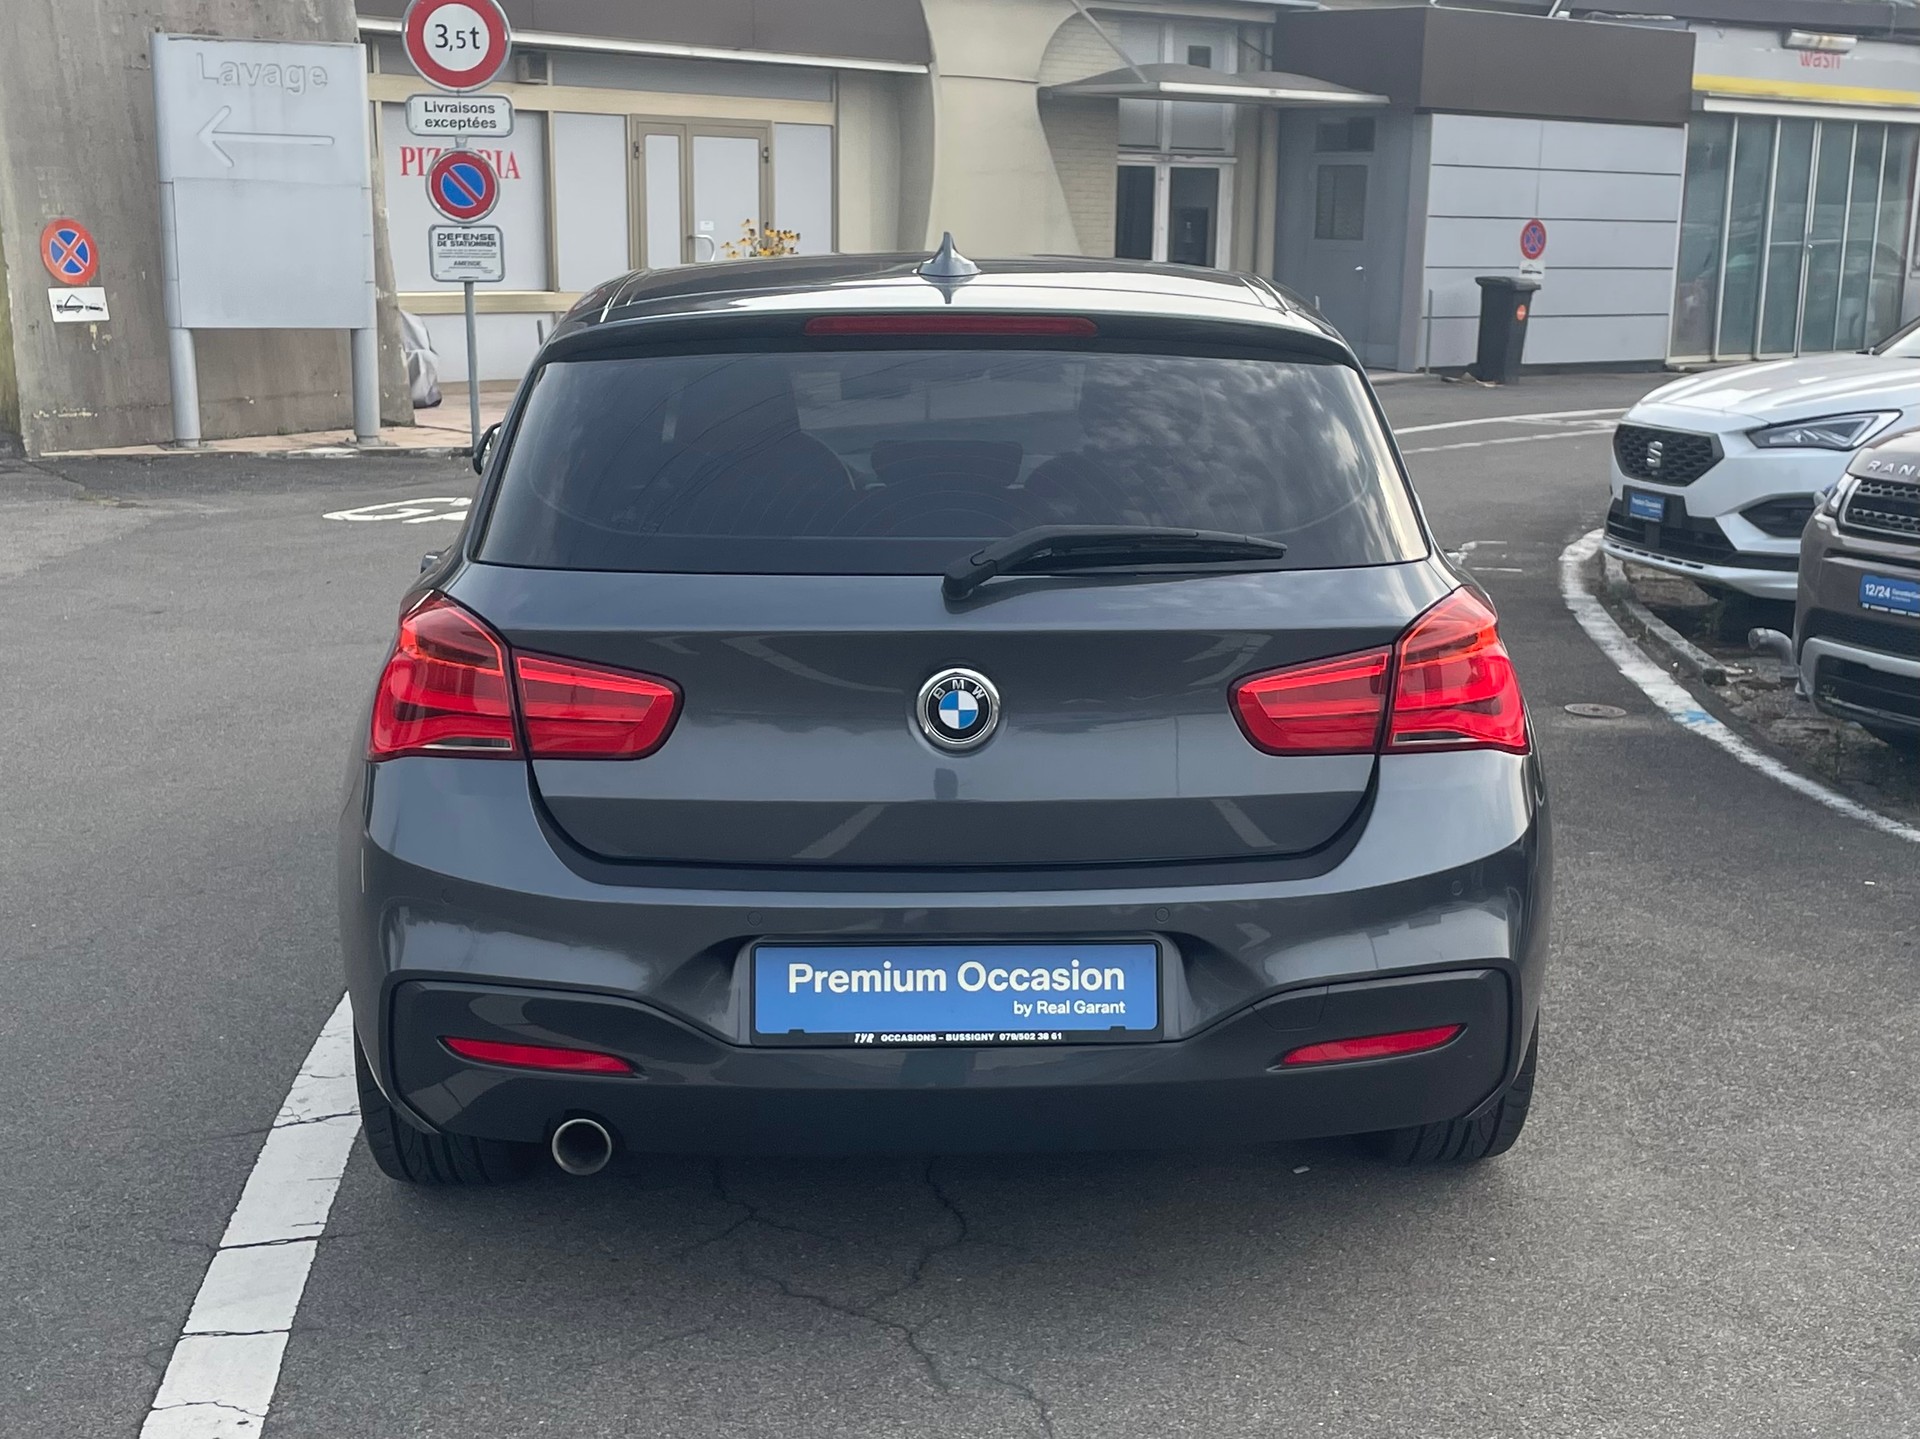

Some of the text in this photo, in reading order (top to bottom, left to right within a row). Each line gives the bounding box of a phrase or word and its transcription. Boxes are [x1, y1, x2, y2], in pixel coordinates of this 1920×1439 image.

[196, 51, 328, 95] Lavage
[424, 101, 496, 114] Livraisons
[424, 116, 497, 131] exceptées
[437, 233, 496, 241] DEFENSE
[1867, 460, 1920, 477] RAN
[1865, 583, 1891, 600] 12/24
[933, 679, 985, 700] BMW
[788, 959, 1125, 993] Premium Occasion
[1013, 1000, 1126, 1018] by Real Garant
[880, 1033, 937, 1042] OCCASIONS
[945, 1033, 995, 1042] BUSSIGNY
[1051, 1032, 1062, 1041] 61
